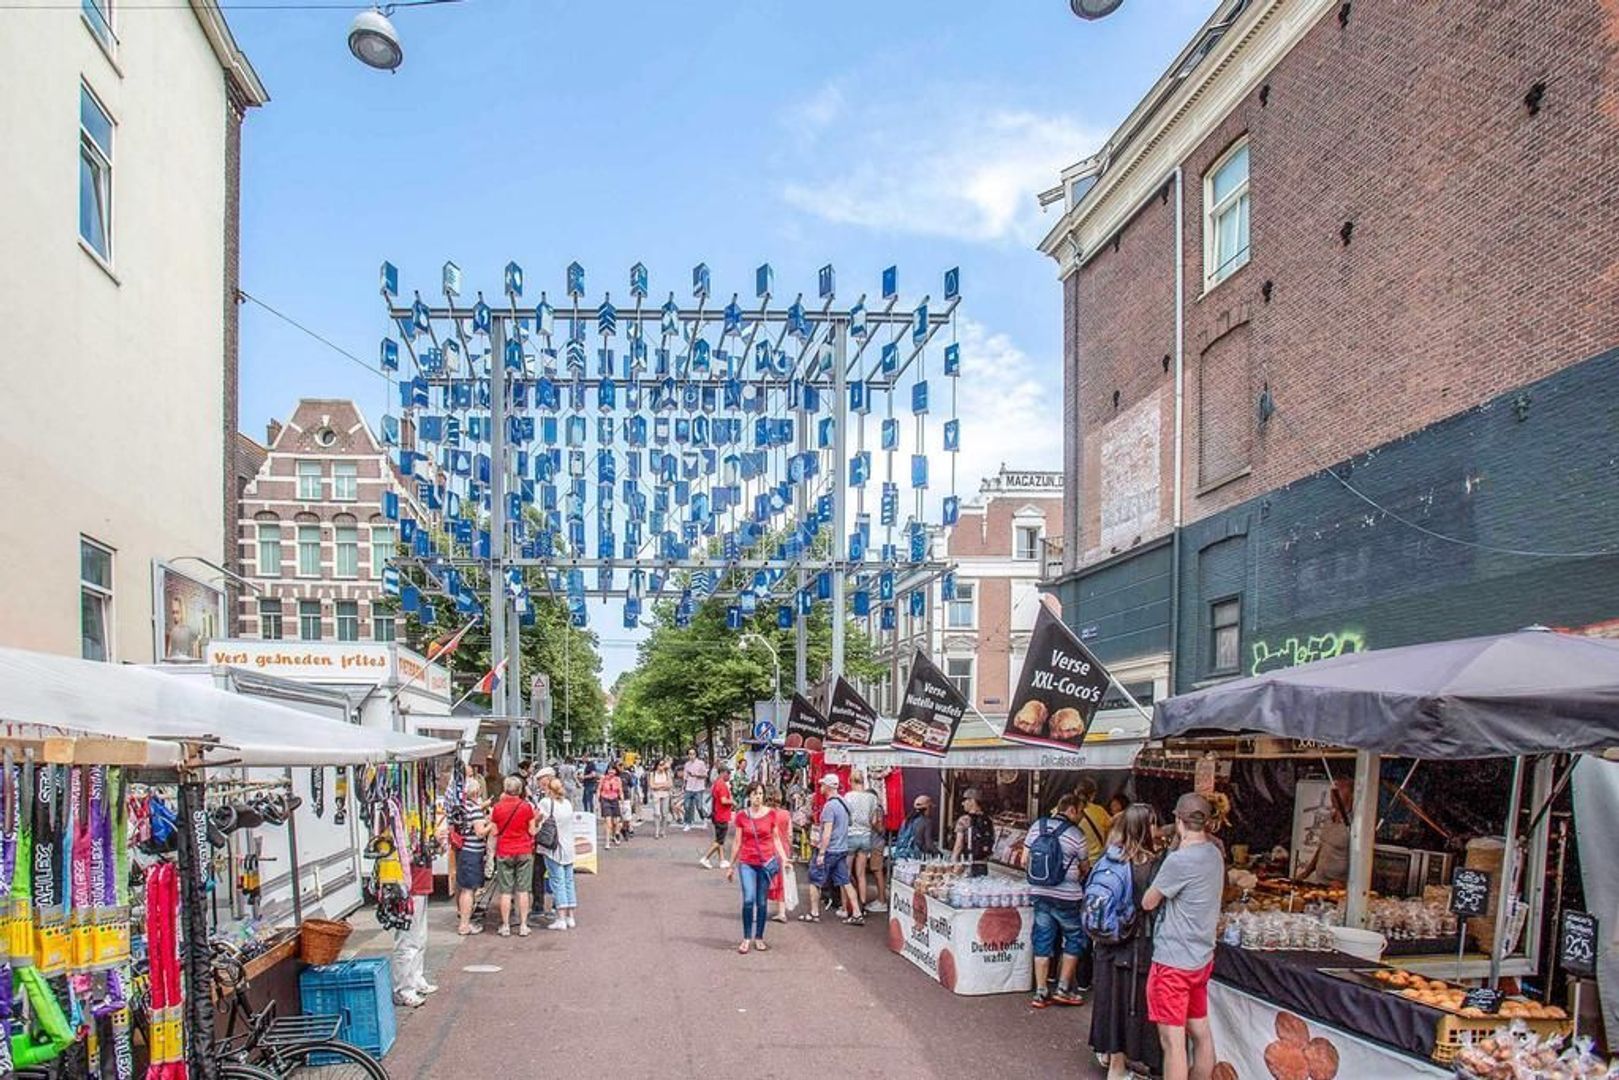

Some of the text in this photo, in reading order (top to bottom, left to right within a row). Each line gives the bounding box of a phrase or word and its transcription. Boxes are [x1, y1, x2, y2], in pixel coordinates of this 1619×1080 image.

[214, 652, 386, 669] Vers gesneden frites
[1051, 649, 1091, 676] Verse
[924, 682, 947, 698] Verse
[1031, 670, 1101, 702] XXL-Coco's
[907, 694, 962, 718] Nutella wafels
[971, 941, 998, 953] Dutch
[984, 951, 1012, 963] waffle
